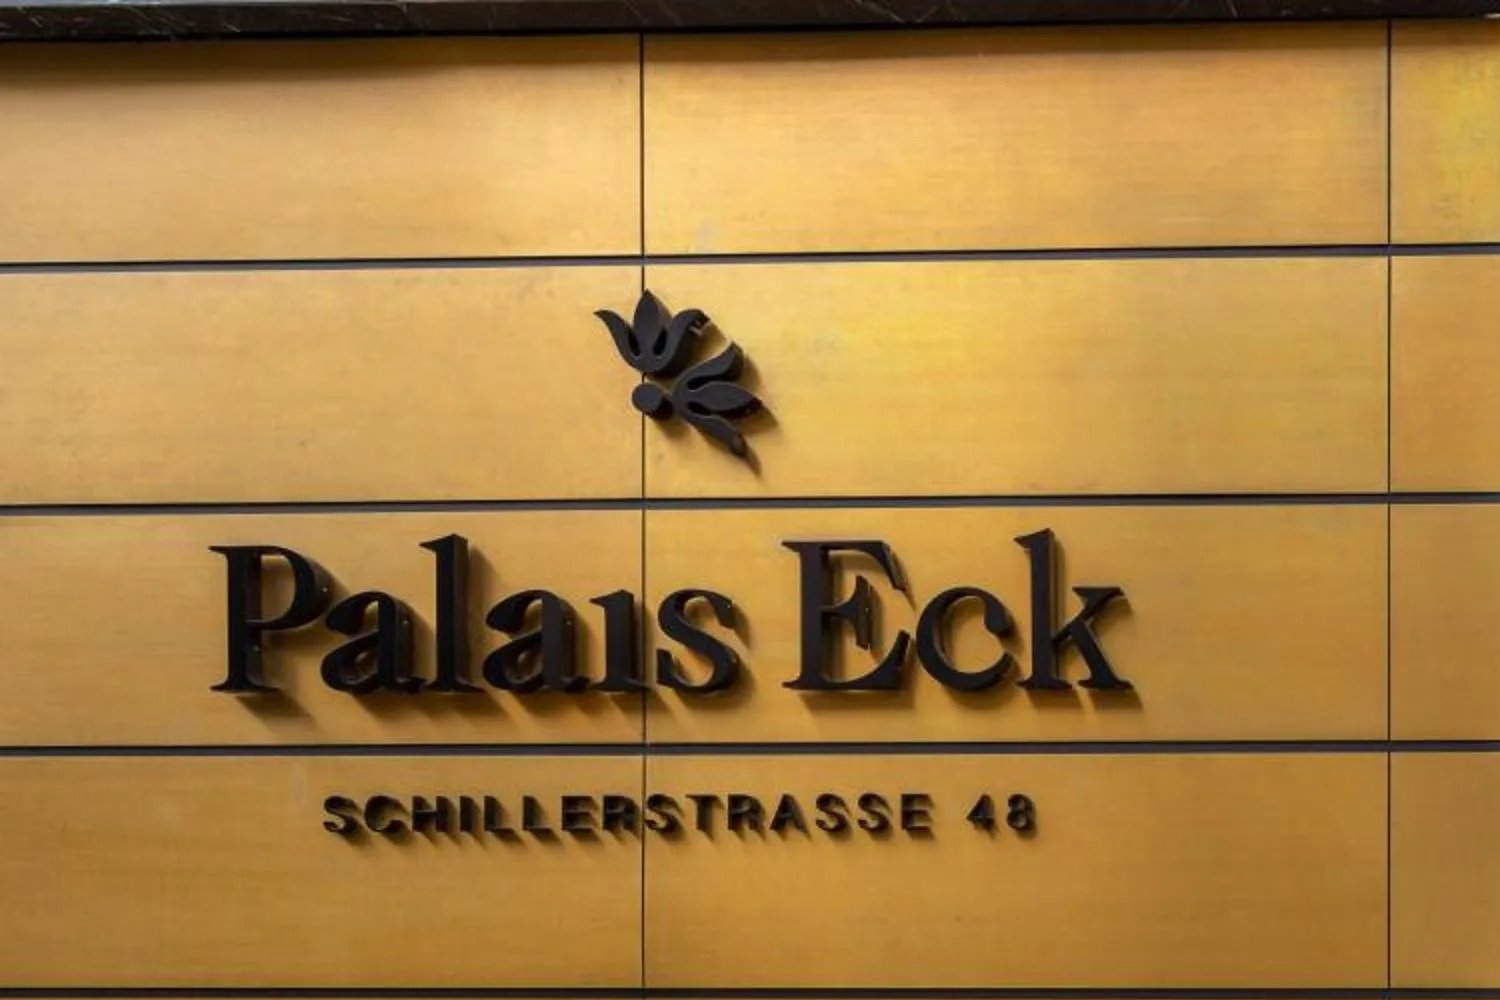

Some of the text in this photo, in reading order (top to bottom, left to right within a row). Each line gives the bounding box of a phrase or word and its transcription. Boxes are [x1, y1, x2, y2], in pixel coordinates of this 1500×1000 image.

[209, 527, 1134, 694] Palais Eck
[322, 792, 1037, 835] SCHILLERSTRASSE 48
